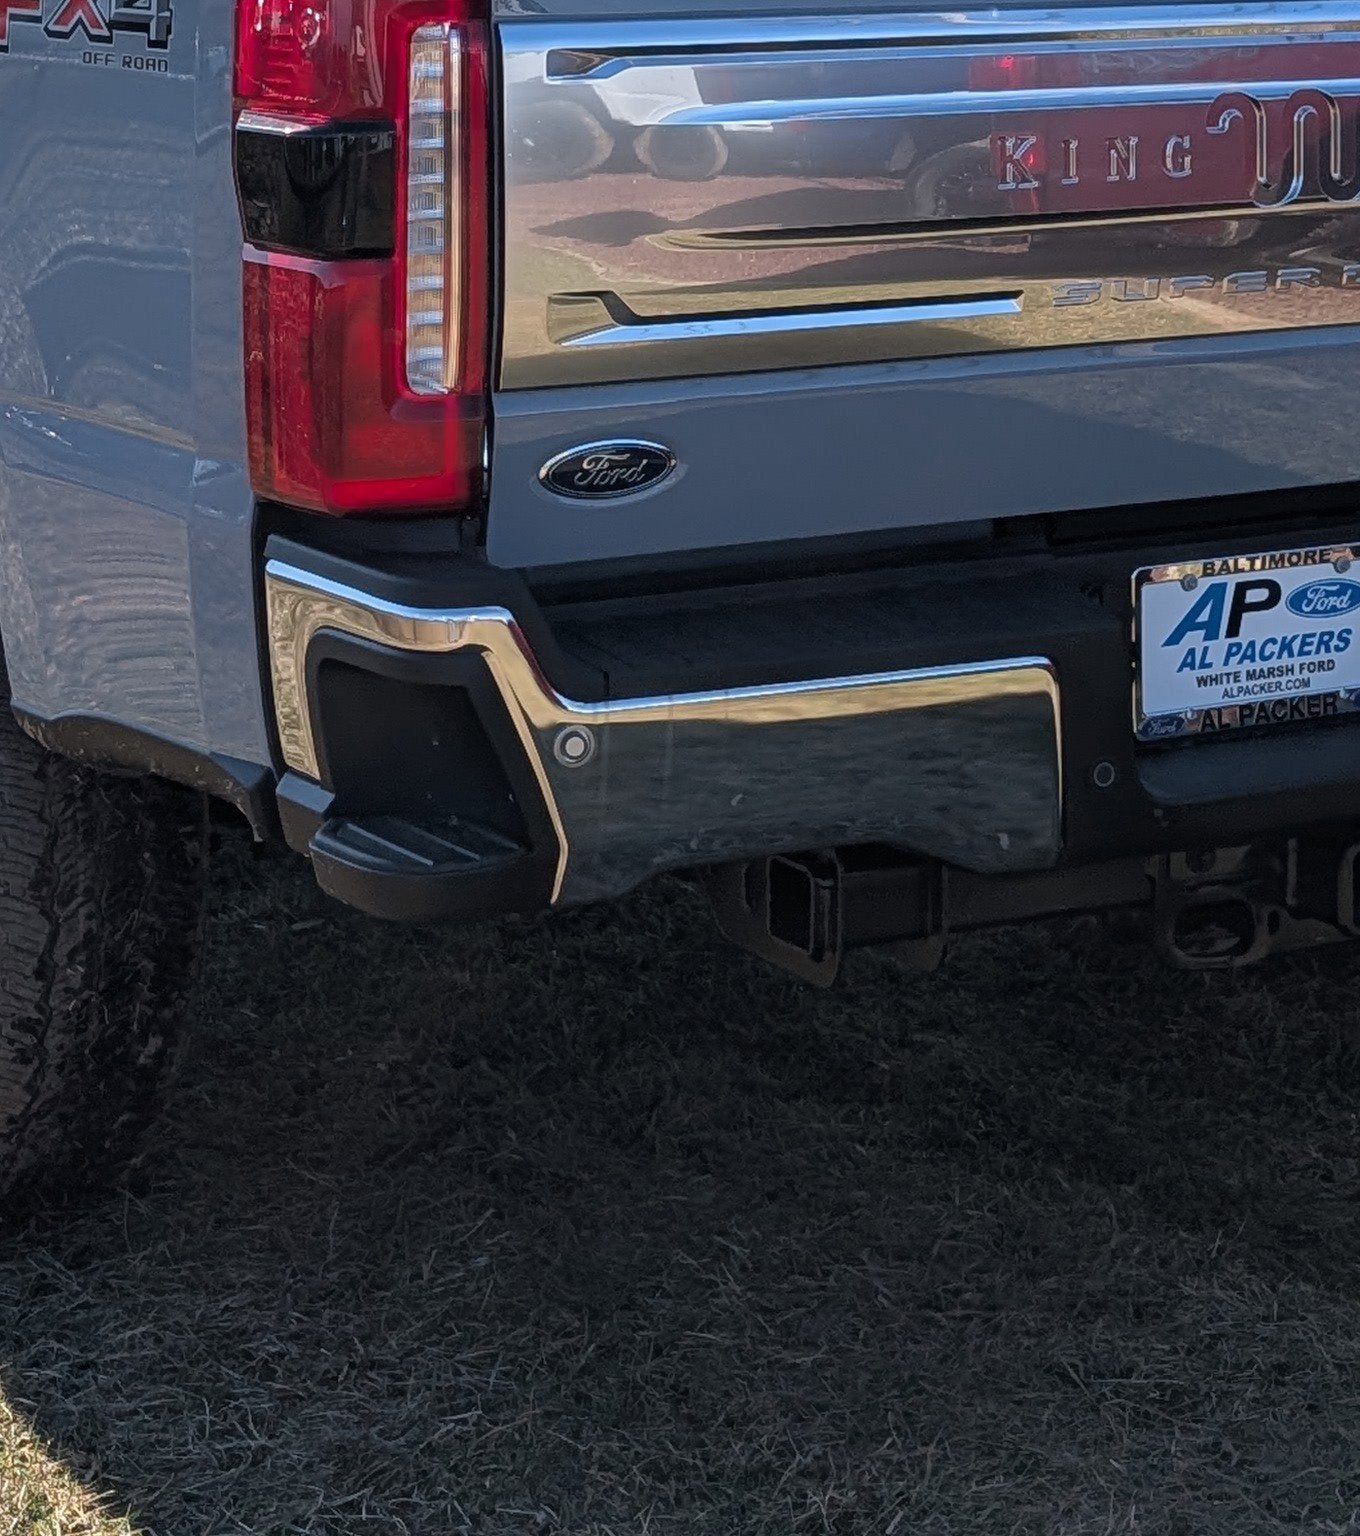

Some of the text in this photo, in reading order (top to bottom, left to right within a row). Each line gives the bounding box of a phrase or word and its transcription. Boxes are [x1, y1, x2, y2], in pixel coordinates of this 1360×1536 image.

[81, 51, 169, 73] OFF ROAD
[997, 134, 1194, 190] KING
[1051, 265, 1321, 308] SUPER
[573, 452, 648, 486] Ford
[1202, 548, 1332, 577] BALTIMORE
[1161, 579, 1282, 648] AP
[1301, 584, 1352, 613] Ford
[1176, 628, 1353, 673] AL PACKERS
[1196, 659, 1336, 689] WHITE MARSH FORD
[1221, 676, 1311, 700] ALPACKER.COM
[1199, 693, 1339, 732] AL PACKER
